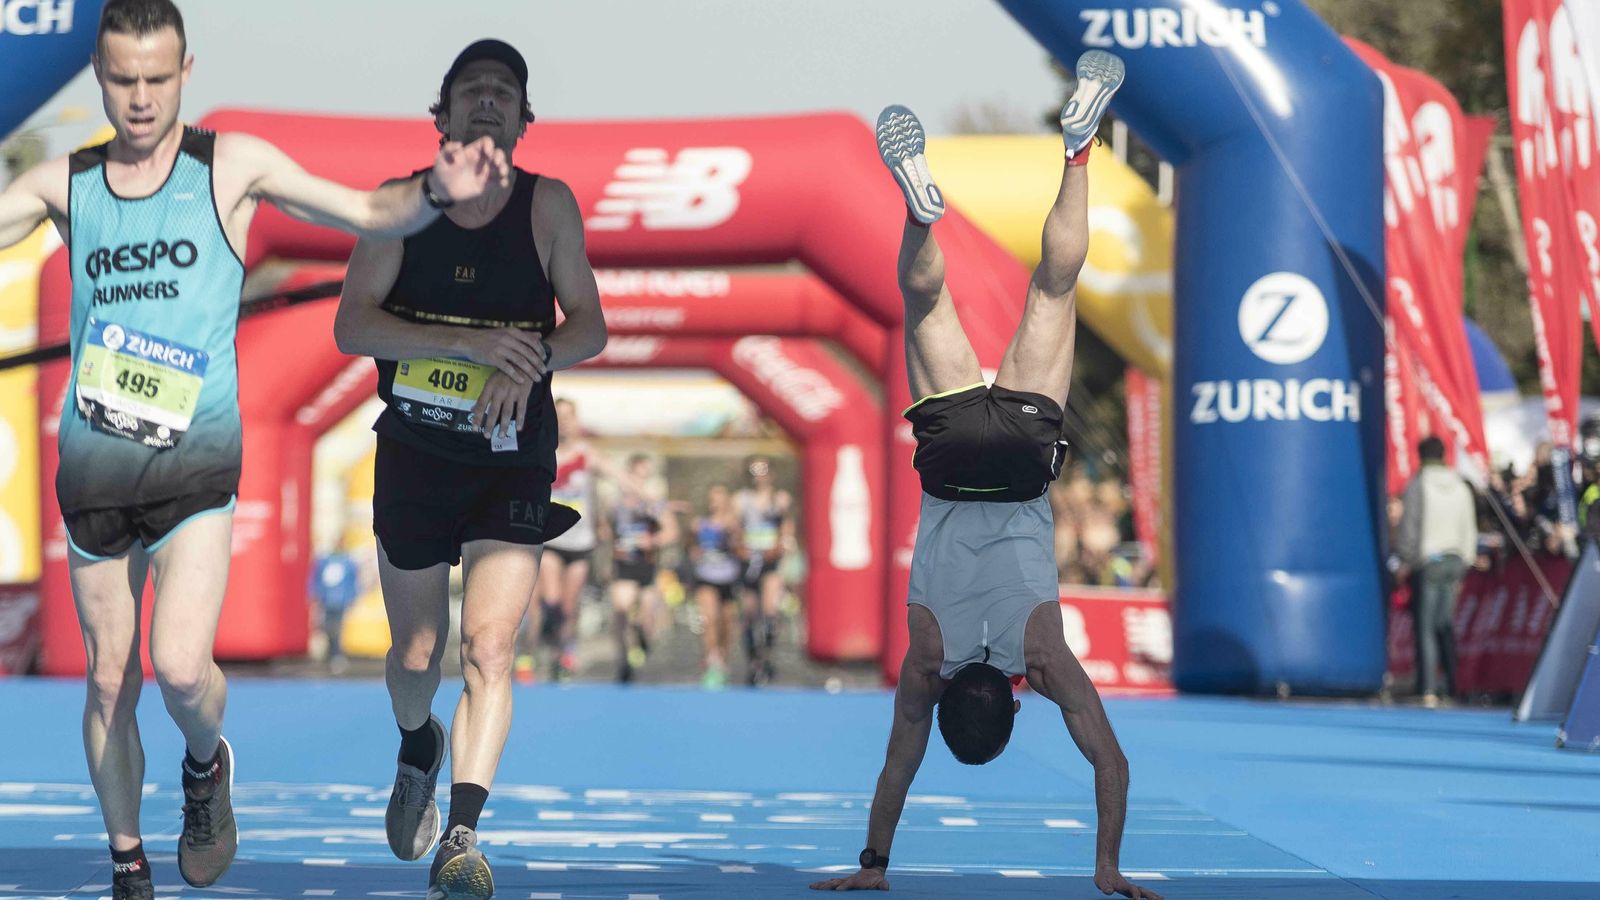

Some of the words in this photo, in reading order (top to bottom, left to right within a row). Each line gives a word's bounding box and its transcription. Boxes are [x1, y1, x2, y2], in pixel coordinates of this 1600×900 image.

[1079, 8, 1266, 49] ZURICH
[85, 239, 198, 281] CRESPO
[455, 265, 476, 280] FAR
[93, 281, 180, 307] RUNNERS
[126, 334, 195, 370] ZURICH
[116, 369, 161, 399] 495
[428, 368, 469, 393] 408
[421, 406, 453, 421] NOSDO
[433, 394, 453, 406] FAR
[1190, 377, 1361, 424] ZURICH
[509, 499, 545, 527] FAR
